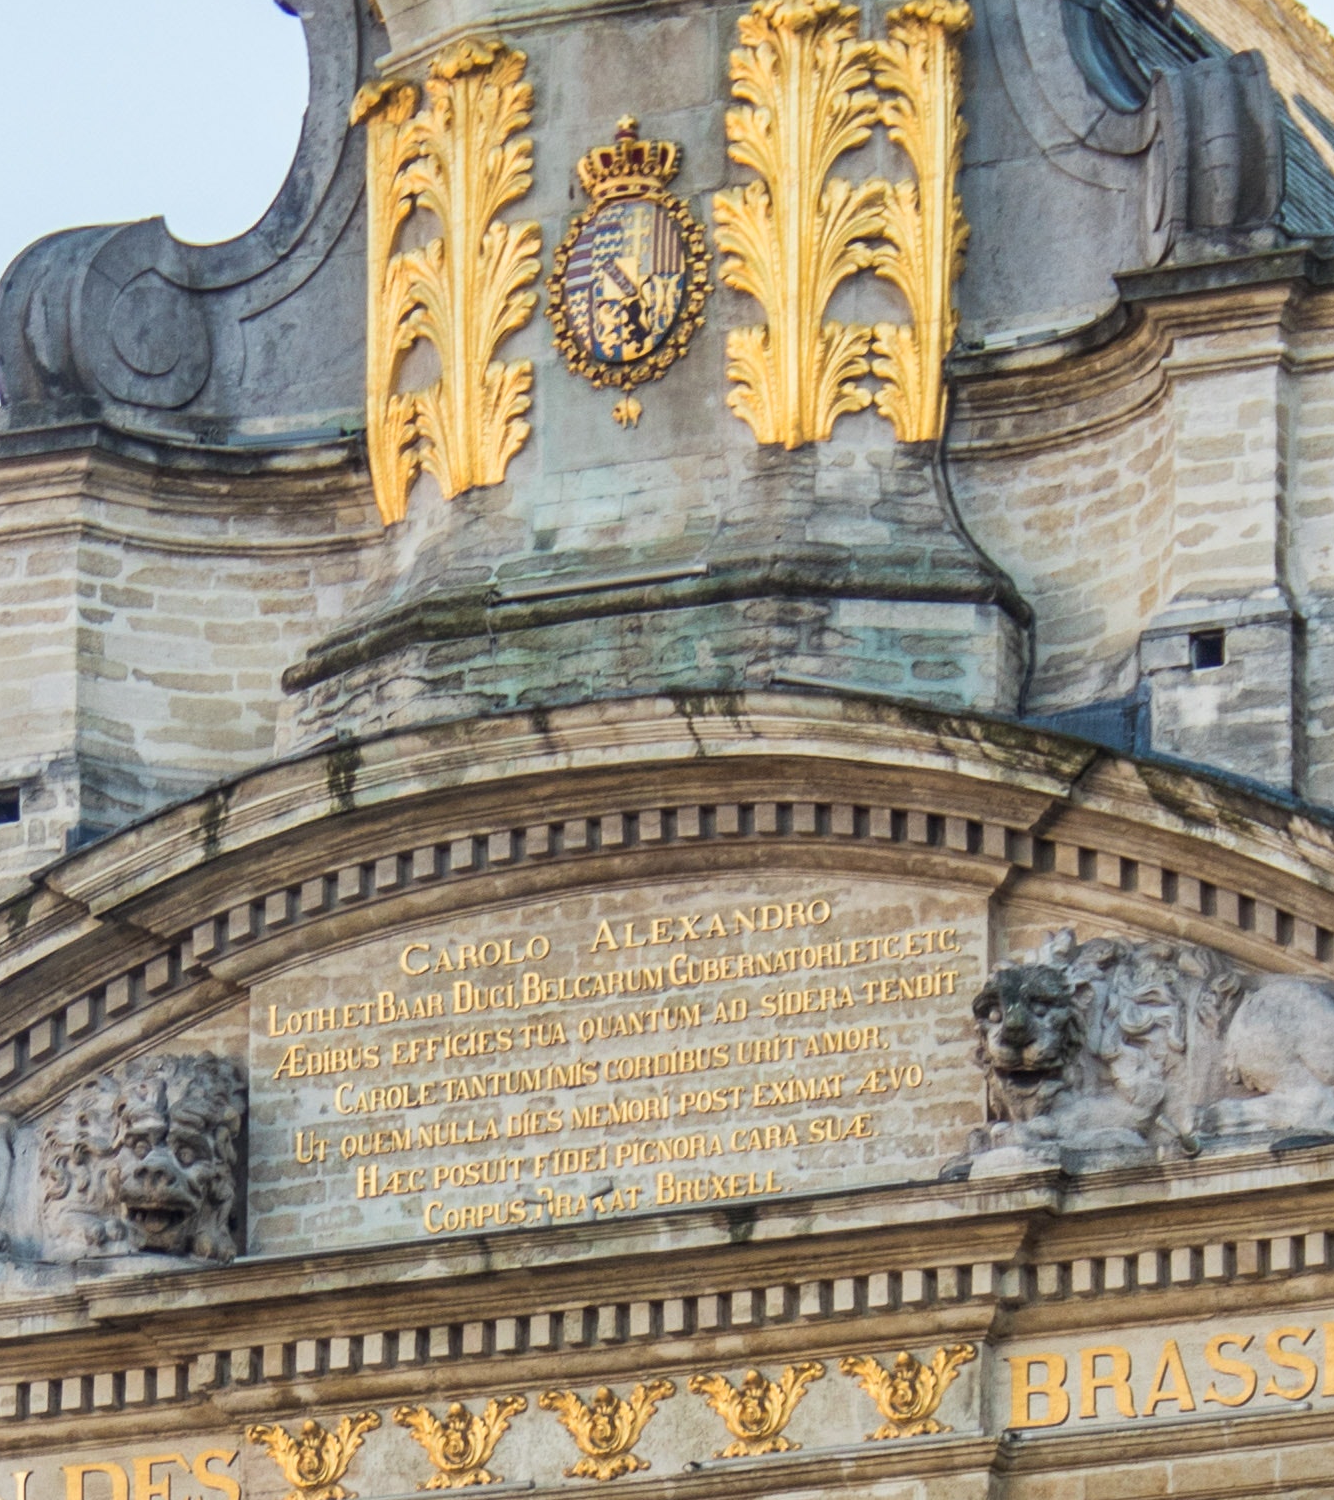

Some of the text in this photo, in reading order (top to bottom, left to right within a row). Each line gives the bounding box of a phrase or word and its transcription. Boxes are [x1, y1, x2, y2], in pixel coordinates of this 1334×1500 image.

[399, 899, 832, 977] CAROLO ALEXANDRO
[377, 990, 445, 1025] BAAR
[520, 1023, 568, 1050] TUA
[578, 1003, 702, 1044] QUANTUM
[713, 998, 749, 1025] AD
[334, 1081, 437, 1116] CAROLE
[441, 1065, 542, 1103] TANTUM
[295, 1130, 331, 1165] UT
[340, 1127, 413, 1161] QUEM
[417, 1117, 500, 1150] NULLA
[680, 1085, 747, 1117] POST
[730, 1123, 800, 1153] CARA
